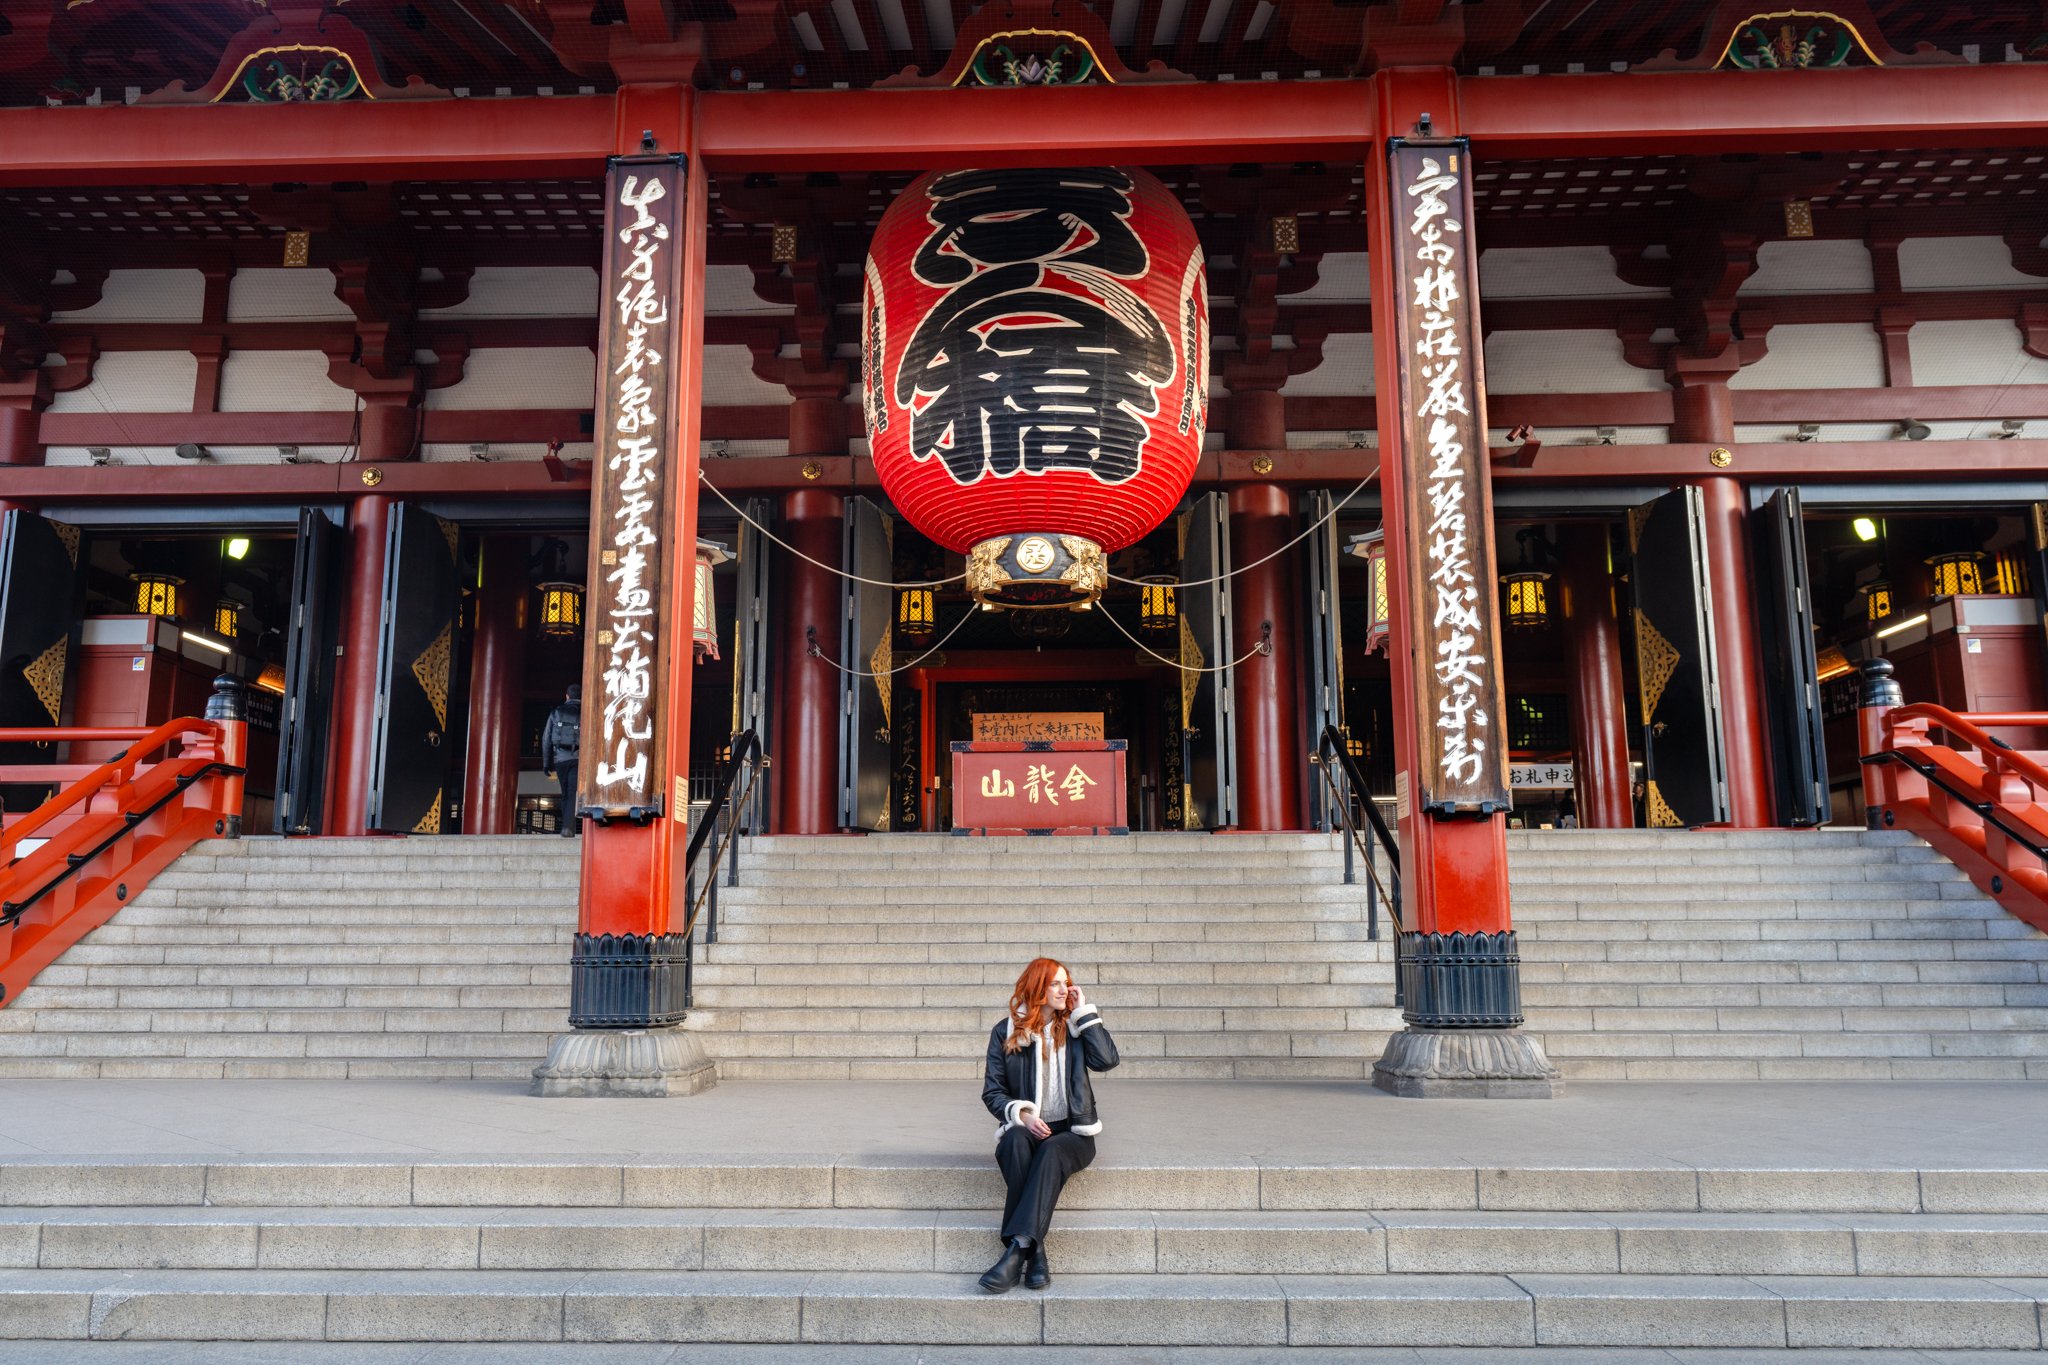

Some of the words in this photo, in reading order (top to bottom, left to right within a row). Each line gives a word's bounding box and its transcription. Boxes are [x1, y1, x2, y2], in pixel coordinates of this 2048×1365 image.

[978, 721, 1102, 736] 本堂内にてご参拝下さい
